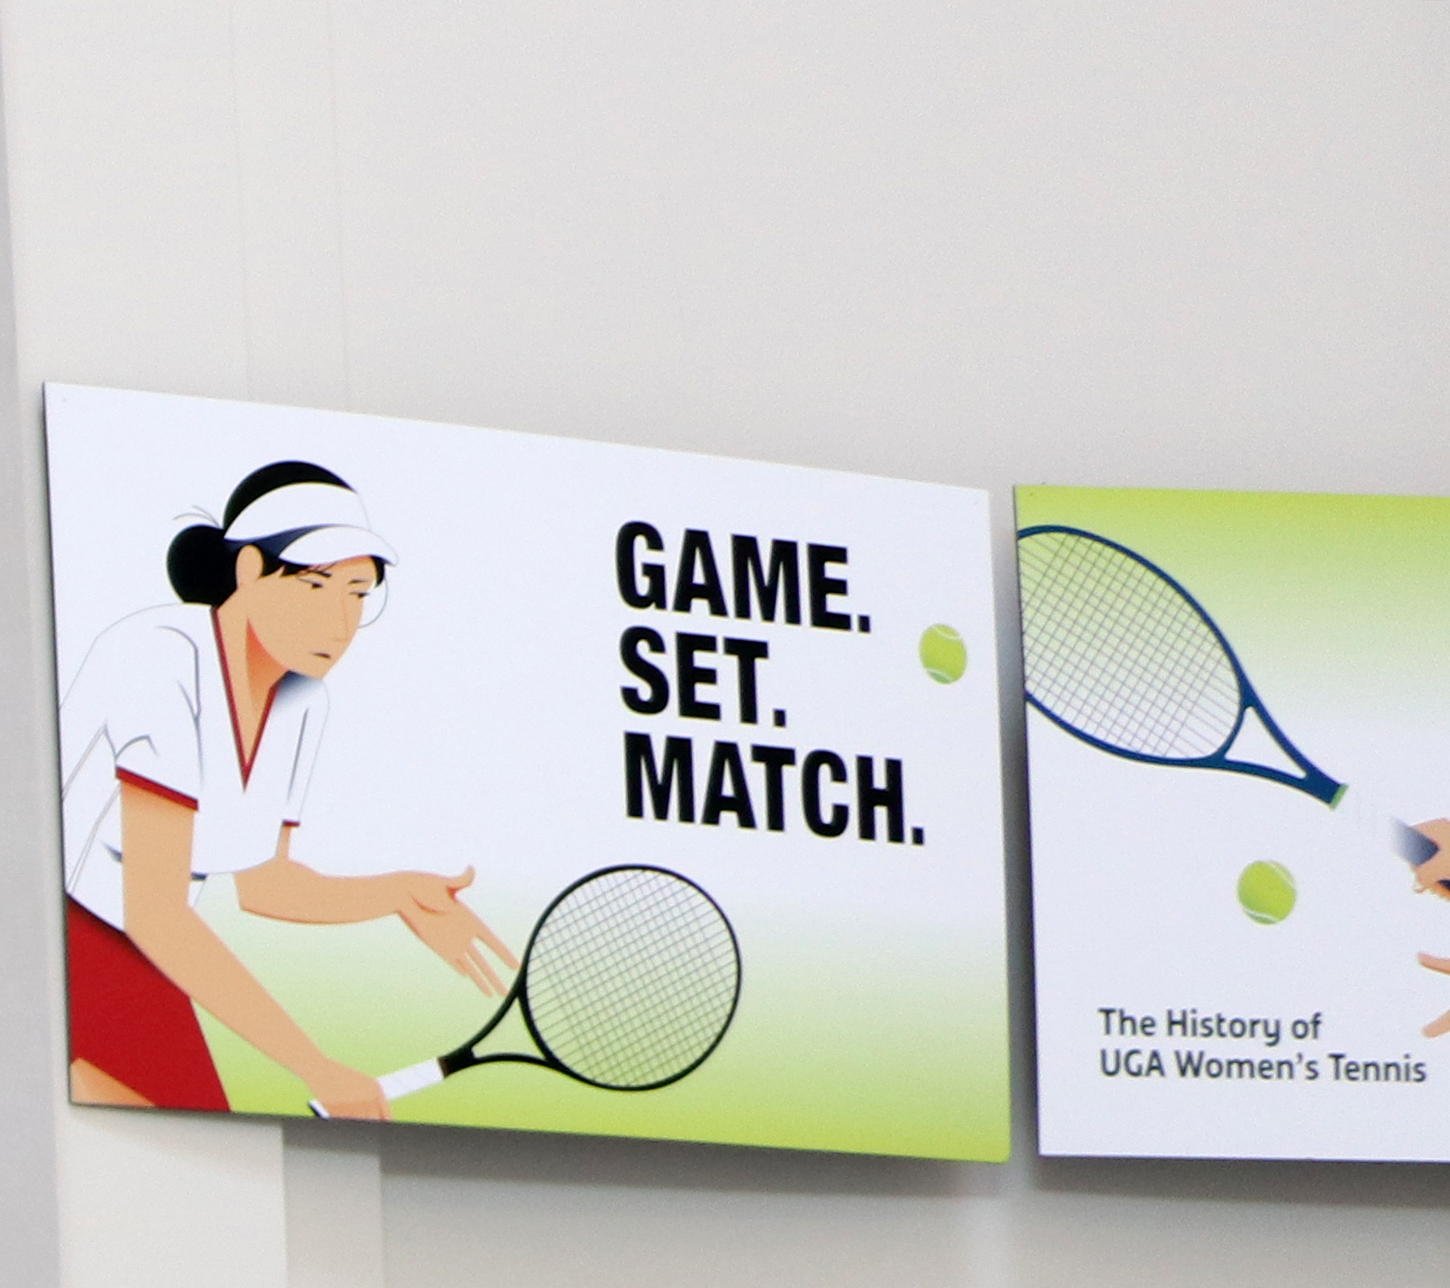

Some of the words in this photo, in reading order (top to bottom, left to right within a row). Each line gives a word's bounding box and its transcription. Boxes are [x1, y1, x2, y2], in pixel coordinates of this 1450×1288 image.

[614, 520, 872, 634] GAME.
[618, 625, 788, 729] SET.
[622, 730, 925, 846] MATCH.
[1098, 1007, 1157, 1039] The
[1165, 1007, 1280, 1046] History
[1290, 1010, 1324, 1040] of
[1098, 1047, 1166, 1078] UGA
[1174, 1049, 1320, 1082] Women's
[1326, 1051, 1428, 1083] Tennis
